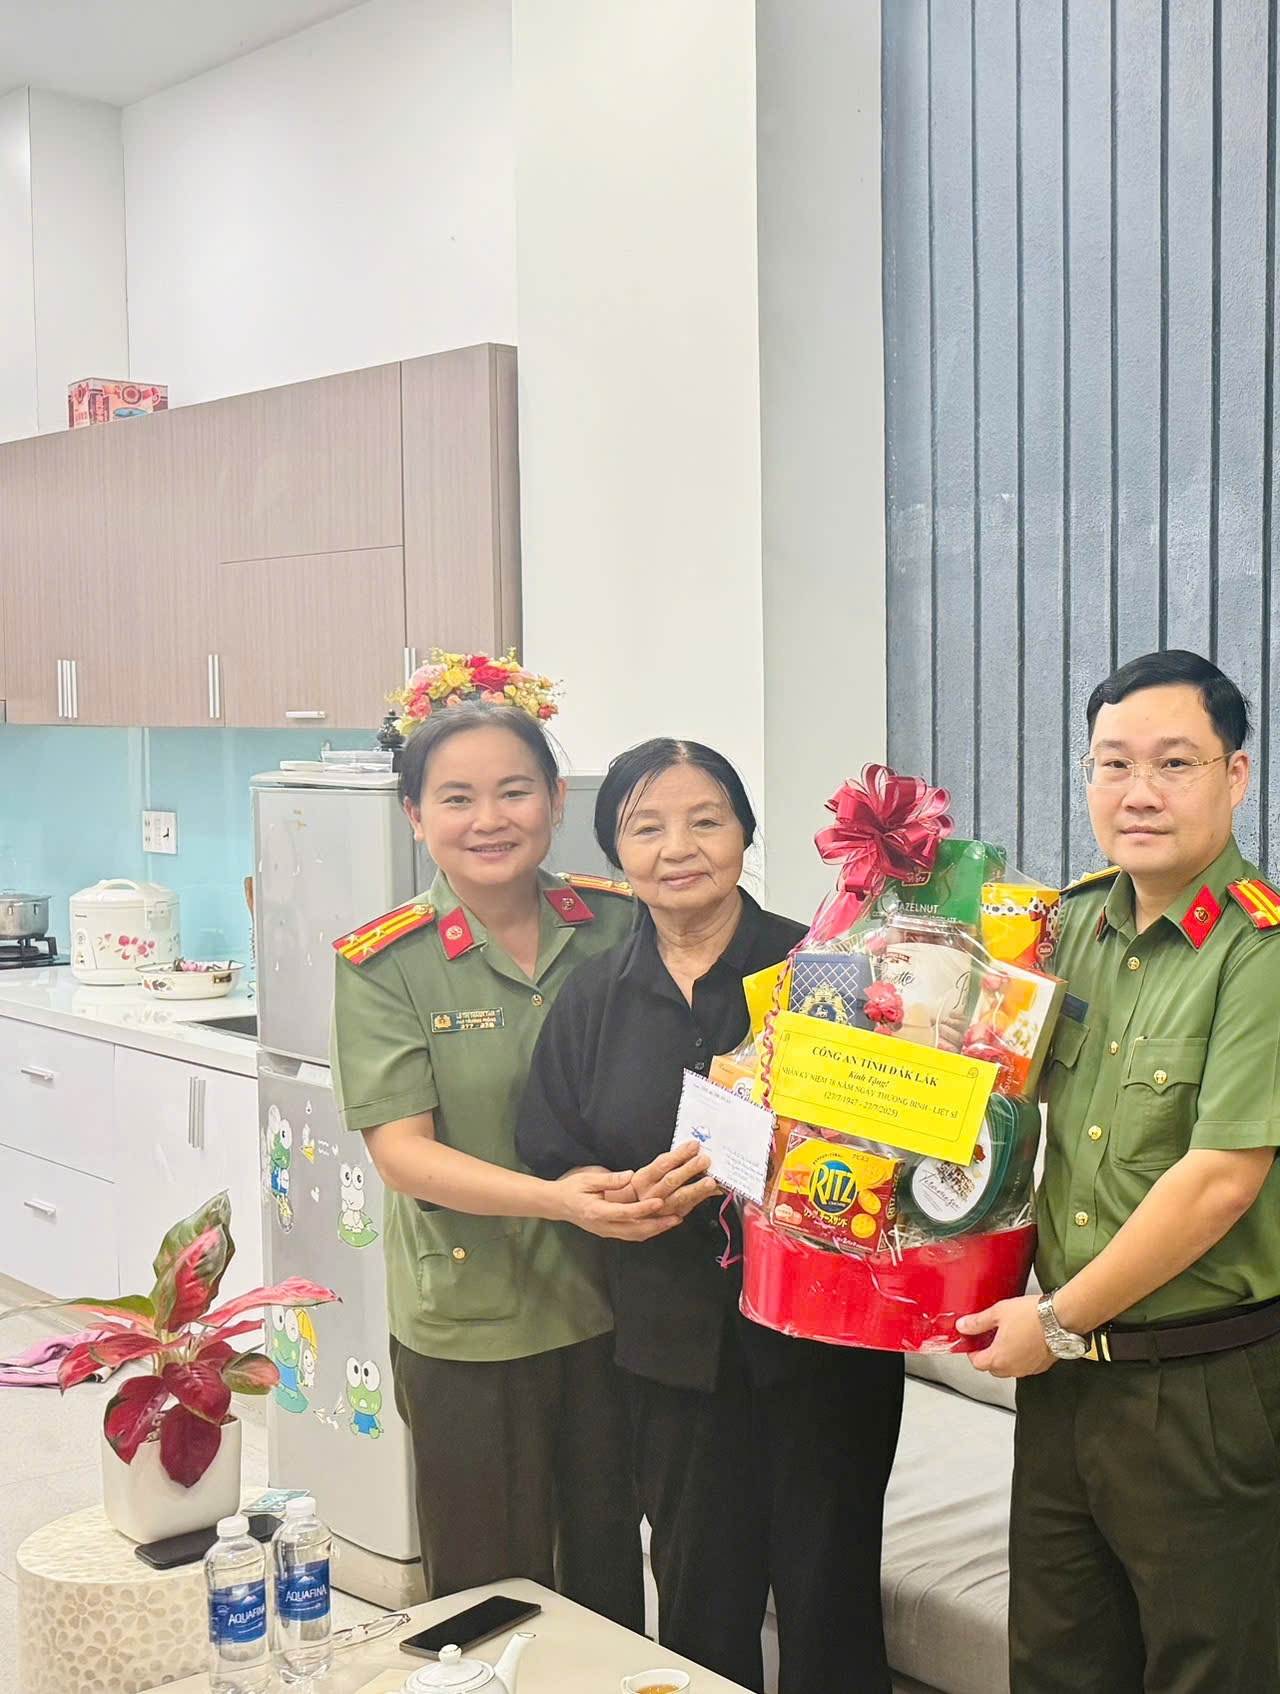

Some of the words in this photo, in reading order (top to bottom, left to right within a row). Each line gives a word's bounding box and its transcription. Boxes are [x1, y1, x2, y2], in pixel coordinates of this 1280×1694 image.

[812, 1046, 842, 1061] CÔNG
[842, 1055, 858, 1065] AN
[861, 1057, 887, 1073] TỈNH
[848, 1071, 866, 1082] Kính
[868, 1076, 890, 1088] Tặng!
[808, 1164, 856, 1205] RITZ
[285, 1584, 328, 1602] AQUAFINA
